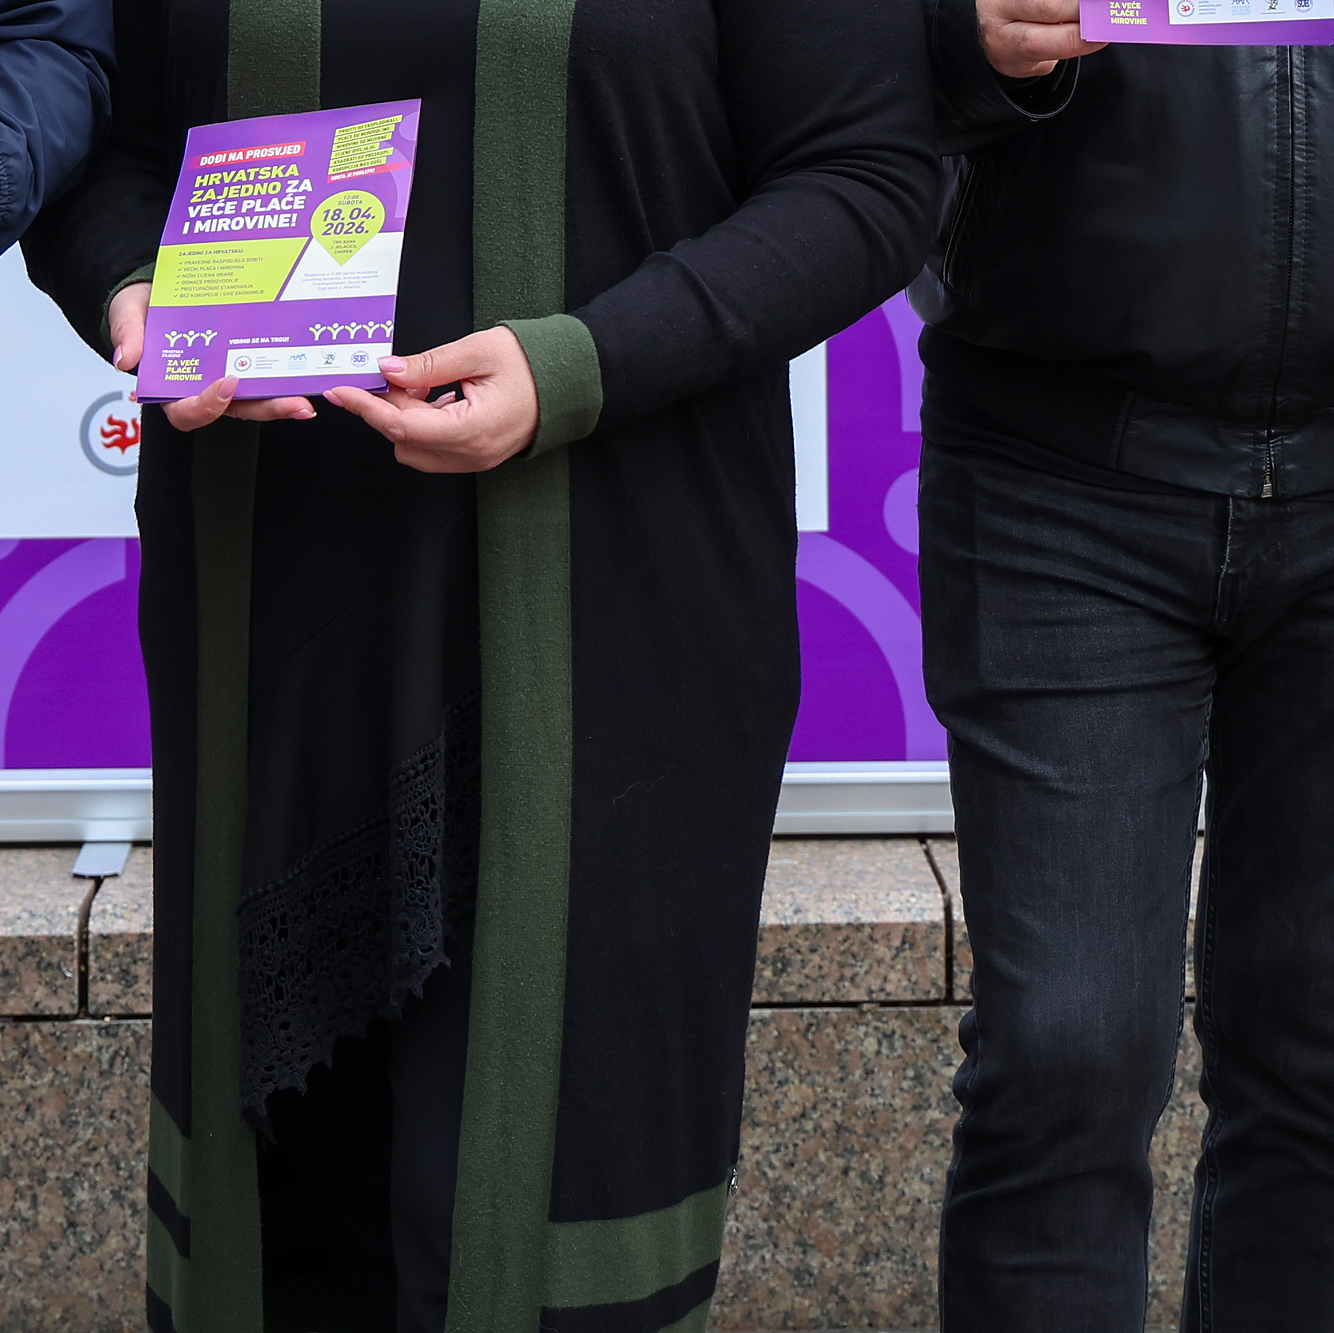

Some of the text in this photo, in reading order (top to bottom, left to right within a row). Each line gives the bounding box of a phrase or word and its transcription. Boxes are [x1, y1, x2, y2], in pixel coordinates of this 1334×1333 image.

[1110, 8, 1135, 16] PLAĆE
[1122, 1, 1141, 9] VEĆE
[199, 143, 301, 166] DOĐI NA PROSVJED
[194, 163, 299, 188] HRVATSKA
[190, 178, 313, 203] ZAJEDNO ZA
[187, 193, 306, 218] VEĆE PLAĆE
[321, 207, 377, 222] 18. 04.
[182, 214, 297, 234] I MIROVINE!
[322, 221, 371, 236] 2026.
[166, 365, 193, 373] PLAĆE
[180, 358, 200, 366] VEĆE
